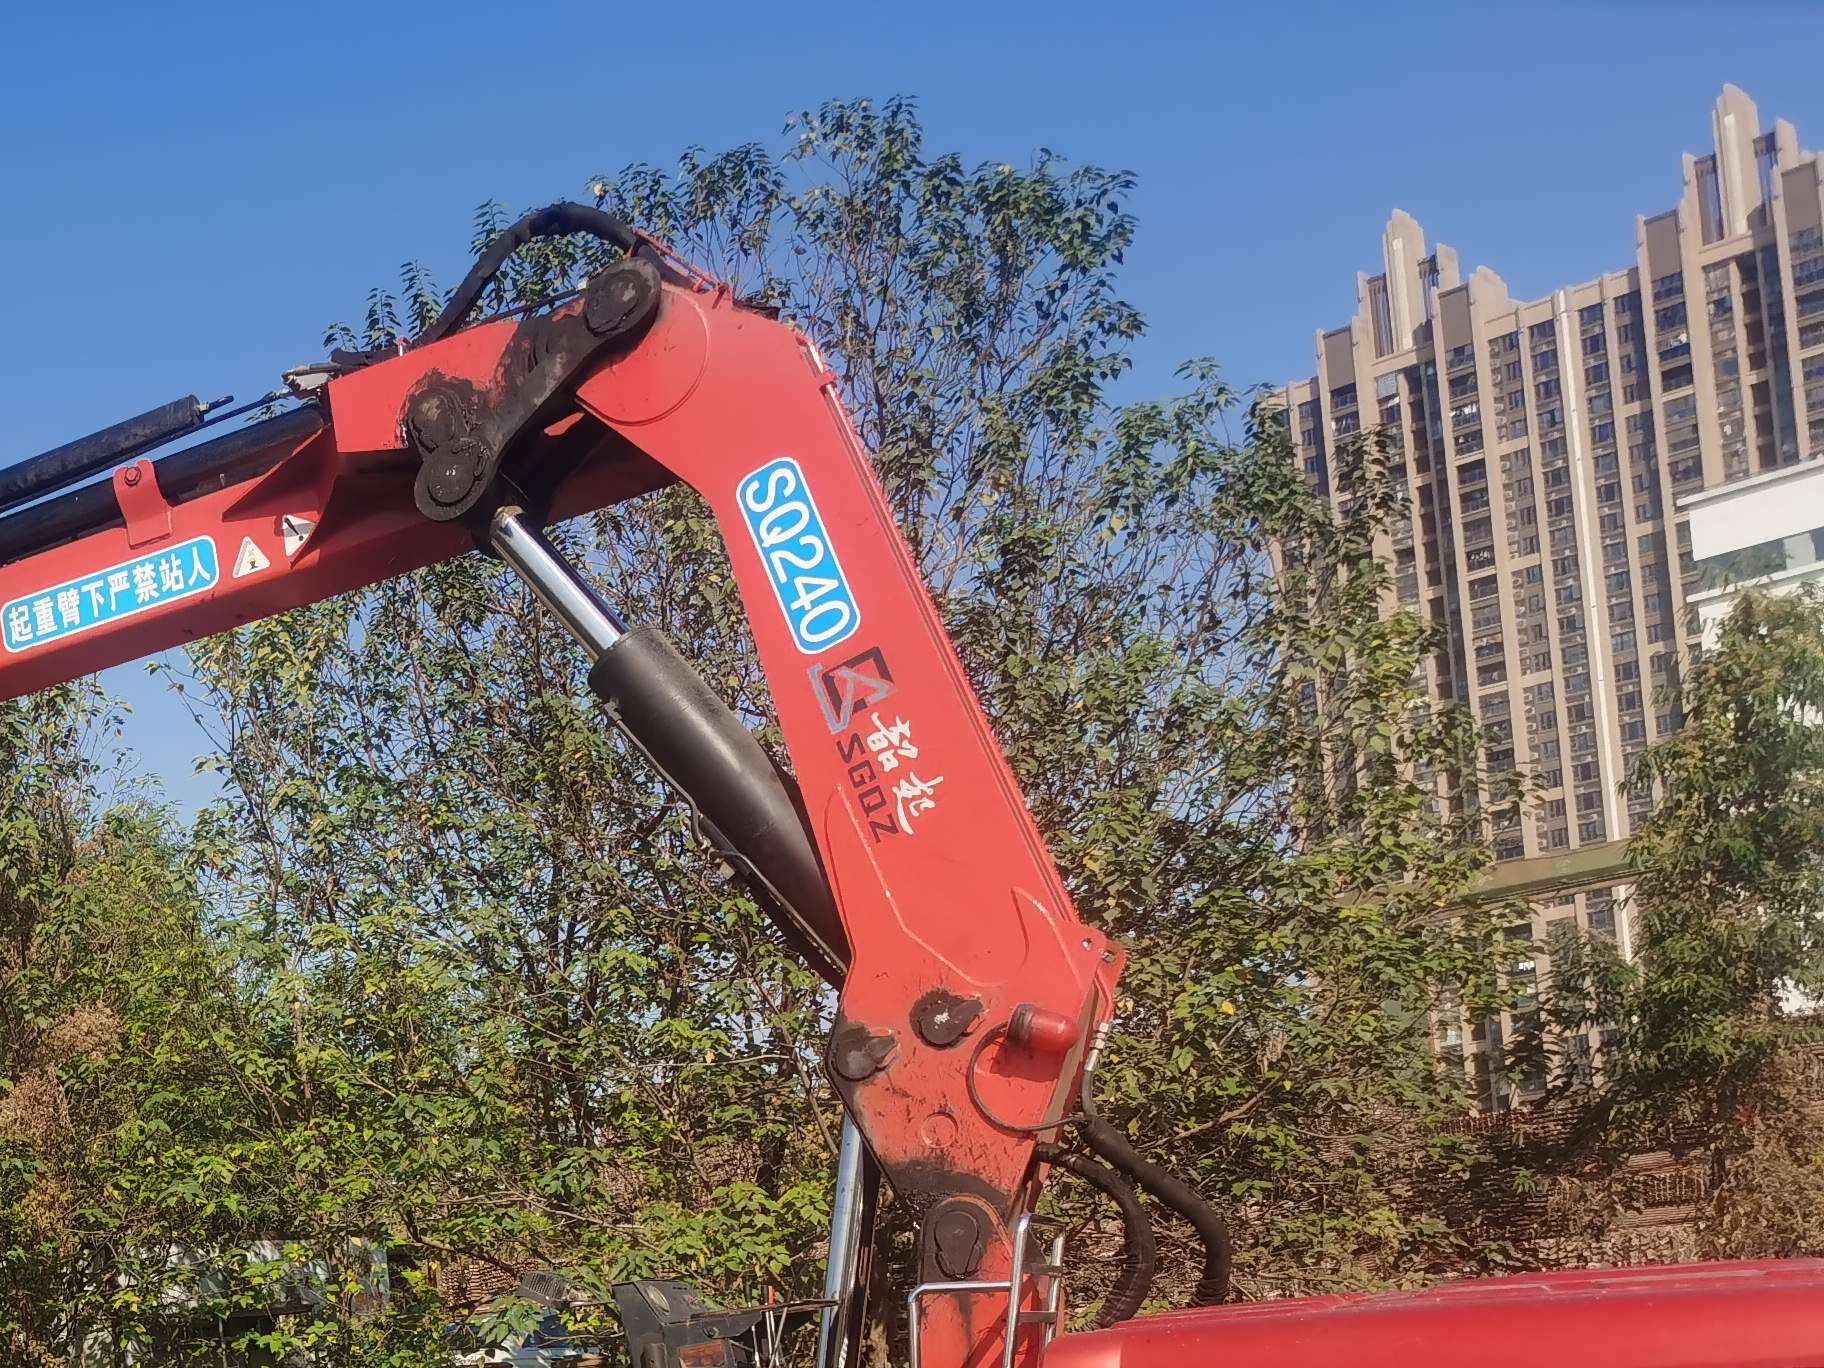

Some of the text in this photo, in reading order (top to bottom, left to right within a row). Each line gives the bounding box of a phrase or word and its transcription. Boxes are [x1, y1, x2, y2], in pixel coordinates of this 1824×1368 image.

[8, 546, 211, 645] 起重臂下严禁站人
[745, 467, 851, 644] SQ240
[836, 732, 899, 843] SGQZ
